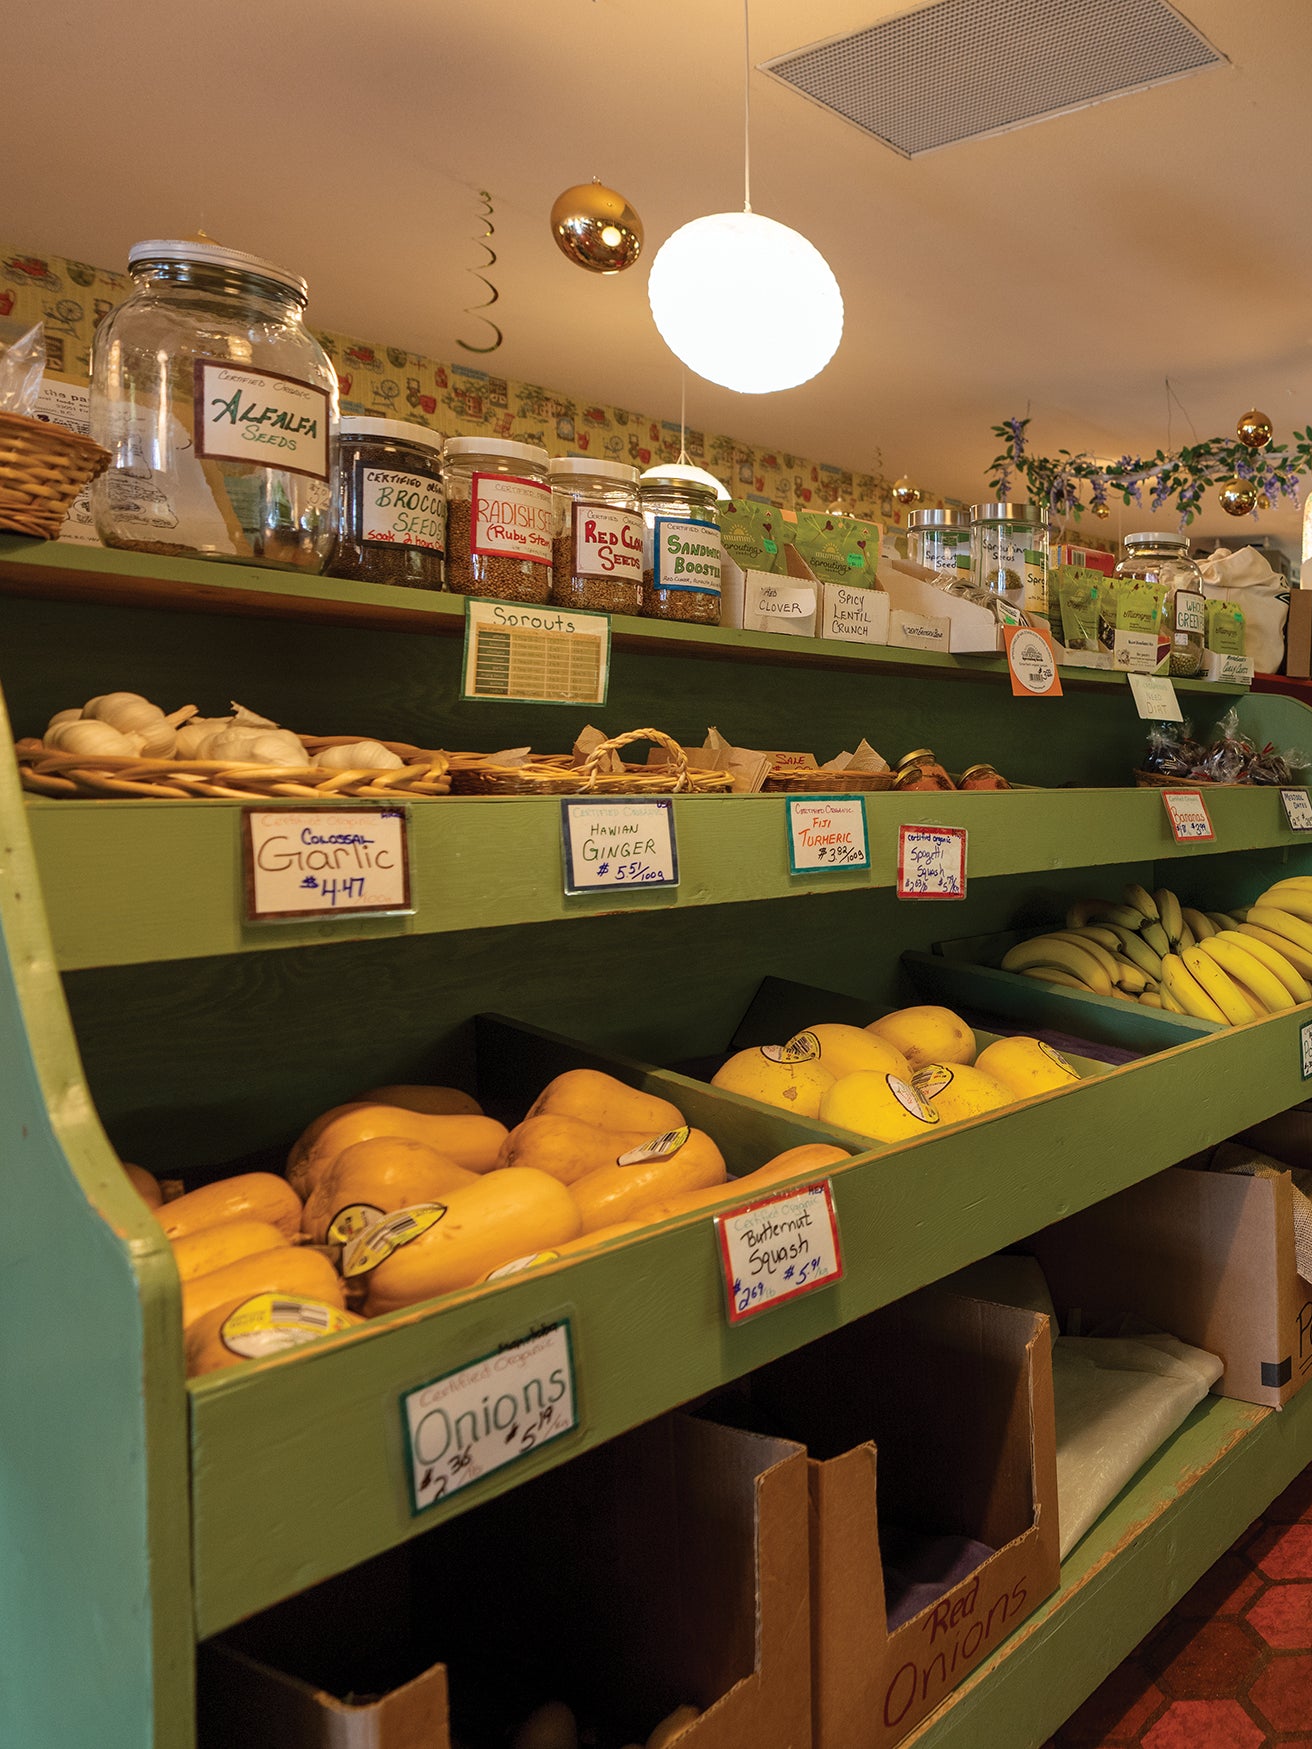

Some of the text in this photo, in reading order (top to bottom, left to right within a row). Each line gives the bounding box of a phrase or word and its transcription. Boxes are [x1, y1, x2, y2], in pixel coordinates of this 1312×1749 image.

[212, 389, 317, 439] ALFALFA
[241, 424, 297, 451] SEEDS
[393, 512, 442, 541] SEEDS
[477, 498, 535, 529] RADISH
[585, 520, 619, 547] RED
[598, 546, 641, 571] SEEDS
[759, 599, 802, 614] CLOVER
[833, 604, 872, 623] LENTIL
[838, 589, 866, 612] SPICY
[493, 607, 576, 633] Sprouts
[831, 620, 869, 637] CRUNCH
[590, 823, 639, 836] HAWIAN
[812, 817, 832, 828] FIJI
[1171, 806, 1206, 826] Bananas
[258, 836, 394, 872] Garlic
[582, 838, 656, 861] GINGER
[740, 1209, 813, 1248] Butternut
[749, 1234, 809, 1275] Squash
[414, 1369, 566, 1466] Onions
[921, 1575, 980, 1646] Red
[883, 1575, 1028, 1729] Onions
